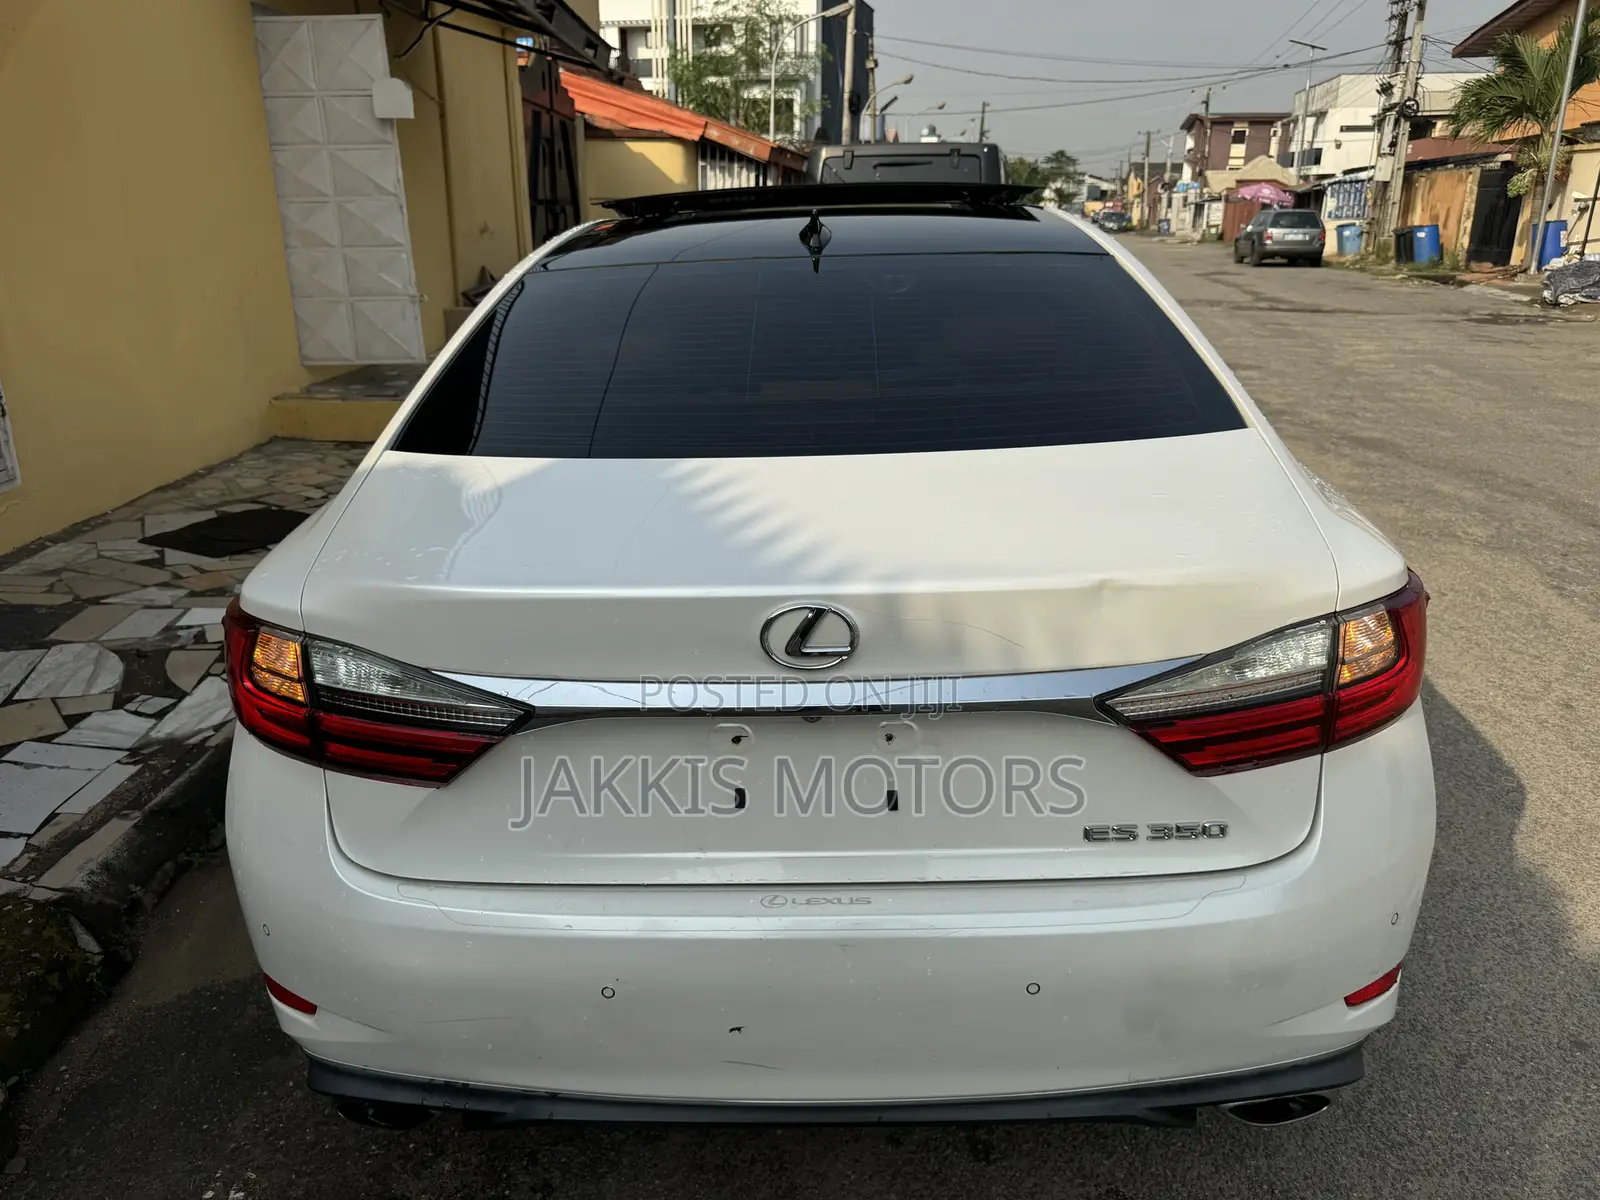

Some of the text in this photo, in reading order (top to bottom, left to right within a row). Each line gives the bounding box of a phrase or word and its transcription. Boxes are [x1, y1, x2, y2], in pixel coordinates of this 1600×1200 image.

[1083, 819, 1228, 842] ES 350
[791, 897, 872, 905] LEXUS
